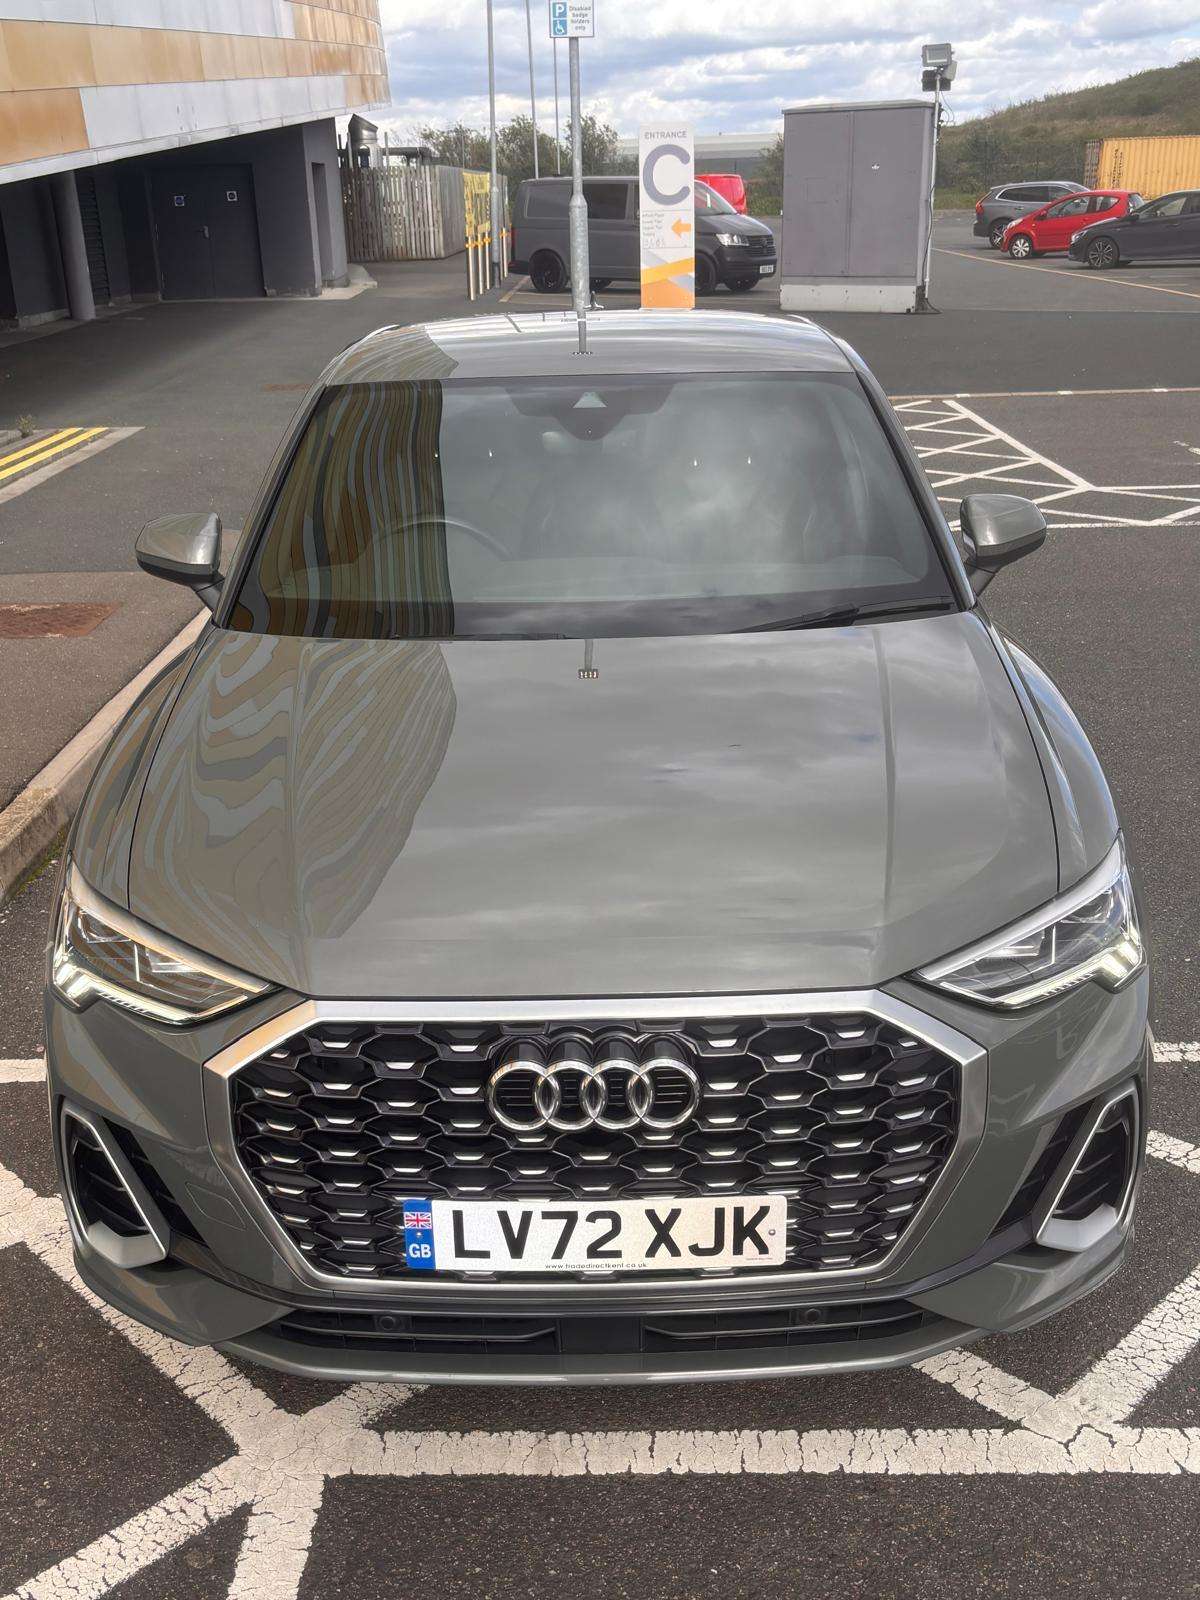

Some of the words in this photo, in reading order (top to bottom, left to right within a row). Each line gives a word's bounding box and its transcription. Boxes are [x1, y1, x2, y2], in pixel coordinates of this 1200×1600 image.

[555, 4, 564, 17] P
[644, 130, 687, 139] ENTRANCE
[643, 144, 690, 206] C
[452, 1209, 622, 1260] LV72
[644, 1205, 771, 1258] XJK
[408, 1243, 431, 1258] GB
